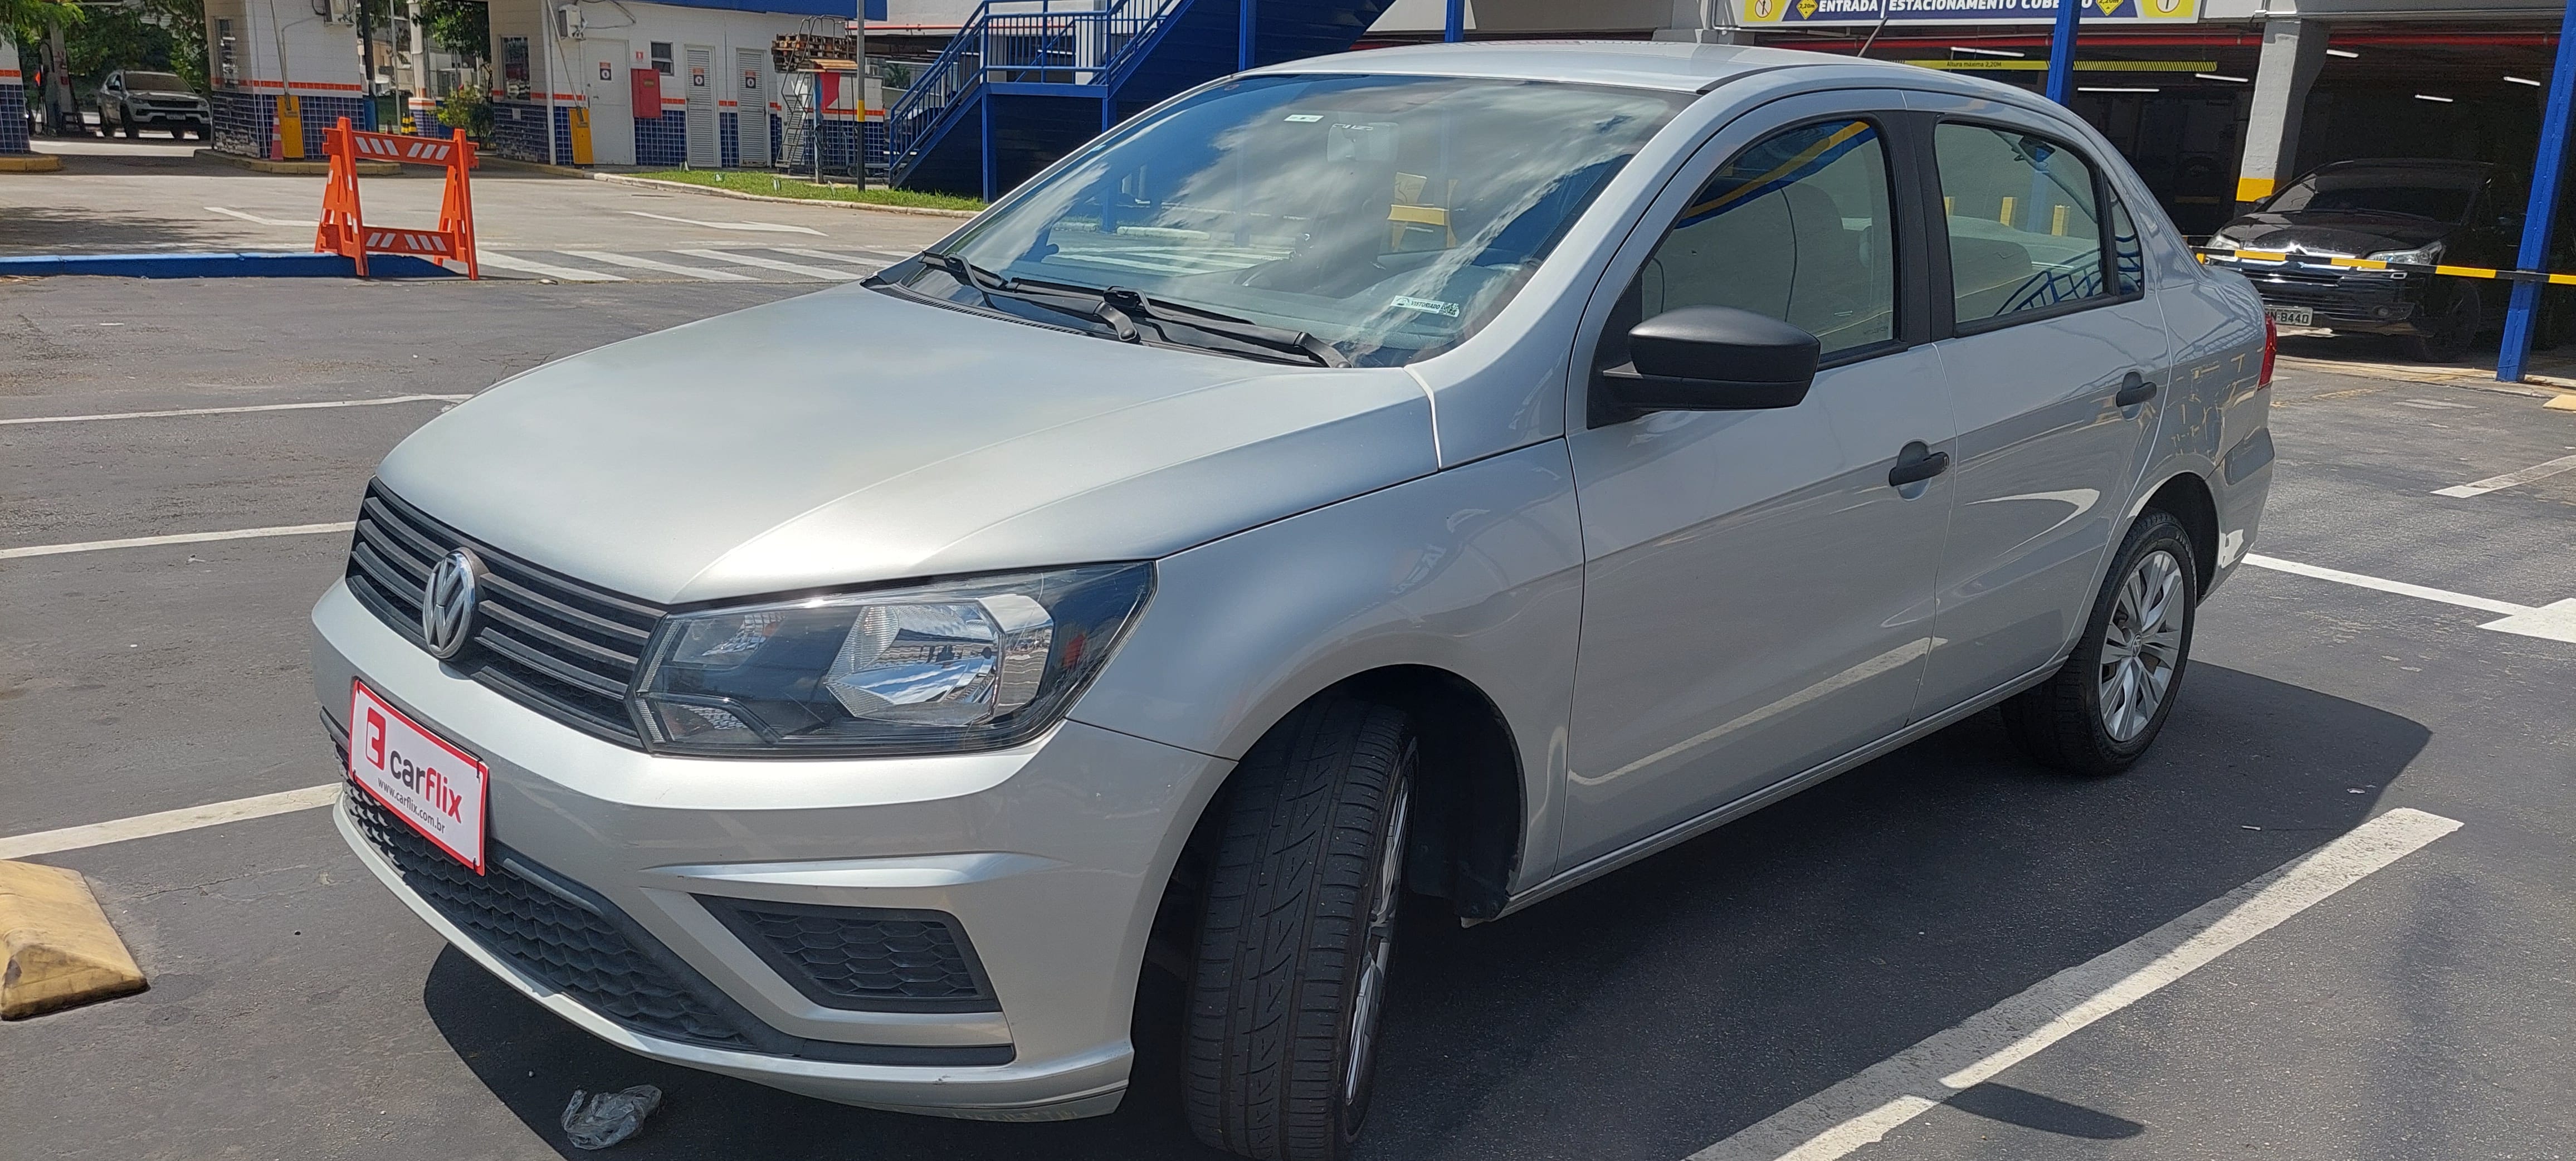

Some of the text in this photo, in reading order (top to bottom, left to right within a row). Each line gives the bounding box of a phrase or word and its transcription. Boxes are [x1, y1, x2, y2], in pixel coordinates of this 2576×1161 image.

[1818, 0, 2092, 12] ENTRADA ESTACIONAMENTO COBEO
[1411, 300, 1441, 309] VISTORIADO
[390, 750, 462, 824] carflix
[378, 777, 445, 834] www.carflix.com.br
